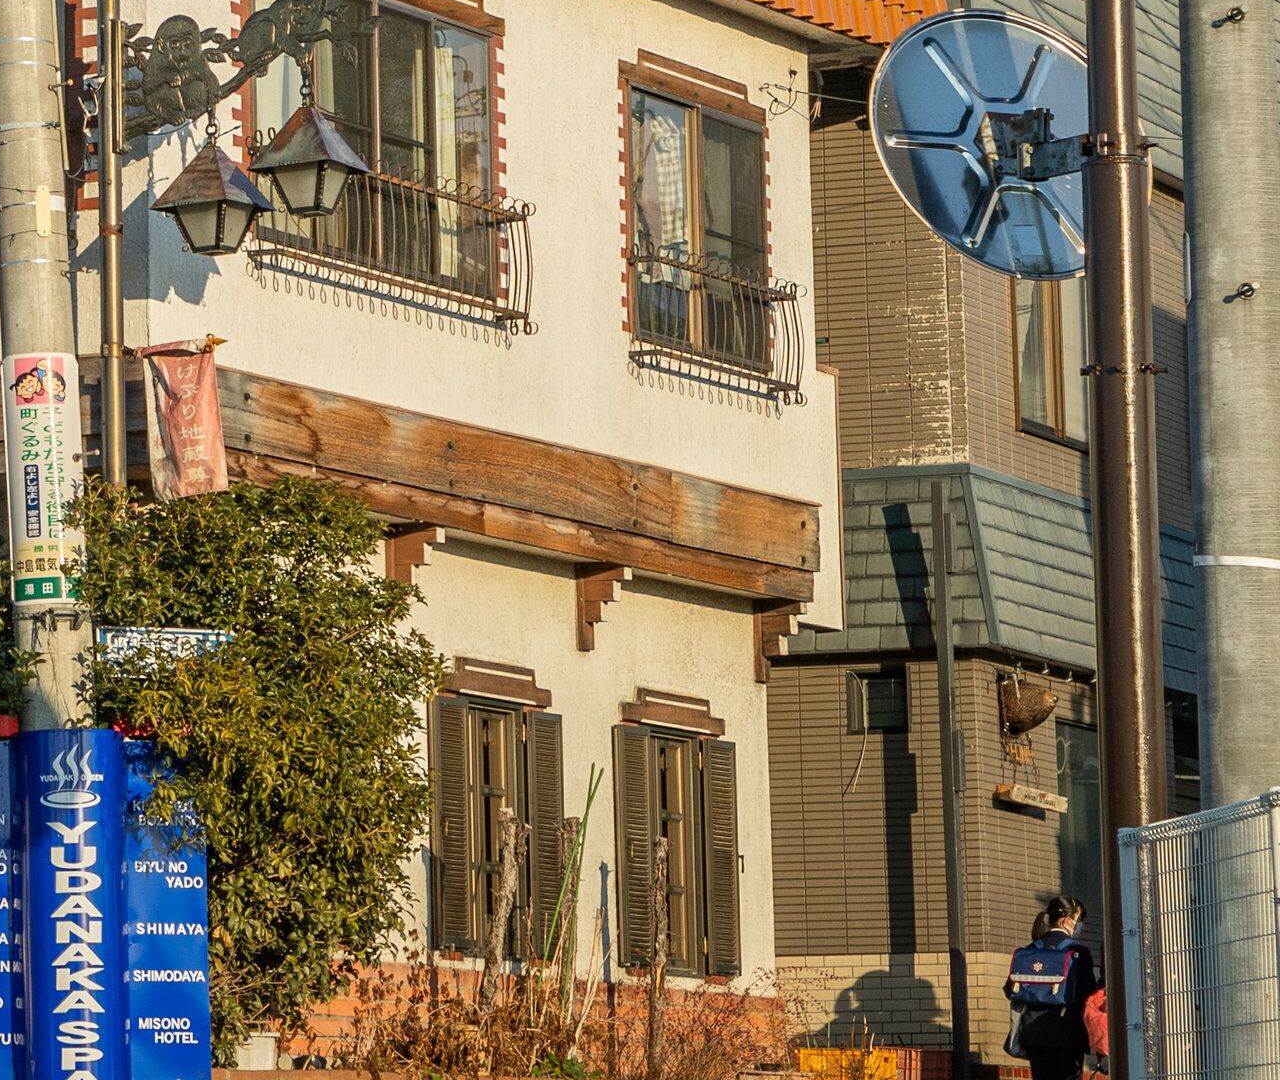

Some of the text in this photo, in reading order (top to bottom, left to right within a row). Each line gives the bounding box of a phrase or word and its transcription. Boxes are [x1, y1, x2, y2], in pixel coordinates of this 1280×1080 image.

[176, 357, 211, 483] けぶり地蔵尊
[20, 408, 40, 461] 町ぐるみ
[135, 861, 188, 873] BIYU NO
[165, 876, 203, 889] YADO
[46, 821, 106, 1014] YUDANAKA
[136, 923, 204, 936] SHIMAYA
[133, 970, 206, 982] SHIMODAYA
[138, 1018, 191, 1030] MISONO
[154, 1031, 198, 1044] HOTEL
